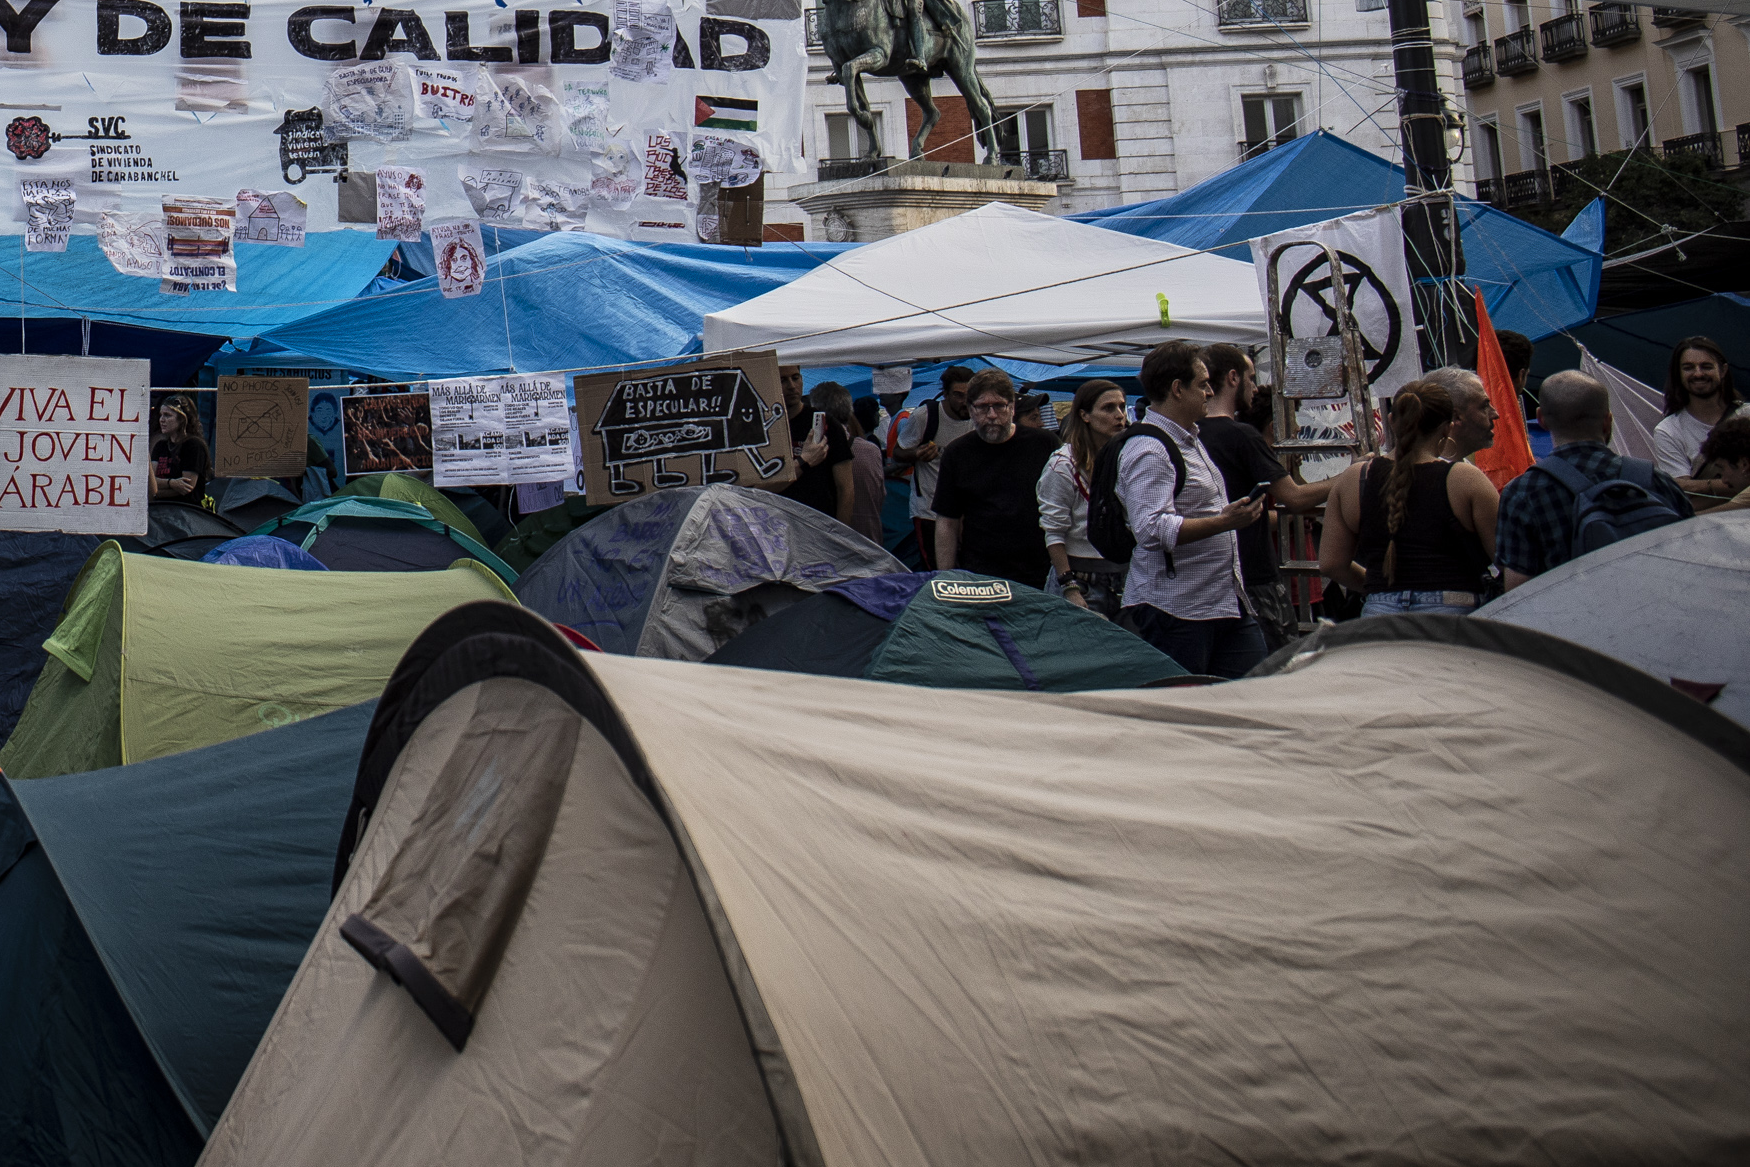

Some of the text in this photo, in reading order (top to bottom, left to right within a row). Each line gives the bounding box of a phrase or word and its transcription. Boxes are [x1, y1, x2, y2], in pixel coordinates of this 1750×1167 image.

[287, 5, 771, 72] CALIDD
[88, 116, 126, 136] SVC
[648, 135, 671, 148] LOS
[89, 145, 141, 156] SINDICATO
[91, 157, 153, 168] DE VIVIENDA
[91, 170, 179, 182] DE CARABANCHEL
[646, 182, 659, 192] DE
[166, 214, 230, 229] NOS QUEDAMOS!
[216, 266, 226, 276] EL
[223, 380, 280, 392] NO PHOTOS
[432, 384, 451, 397] MÁS
[454, 383, 473, 396] ALLÁ
[518, 380, 538, 393] ALLÁ
[540, 381, 551, 392] DE
[623, 375, 713, 400] BASTA DE
[87, 386, 140, 422] EL
[625, 395, 723, 419] ESPECULAR!!
[3, 431, 137, 464] JOVEN
[223, 448, 279, 468] NO FOTOS
[937, 582, 995, 596] Coleman
